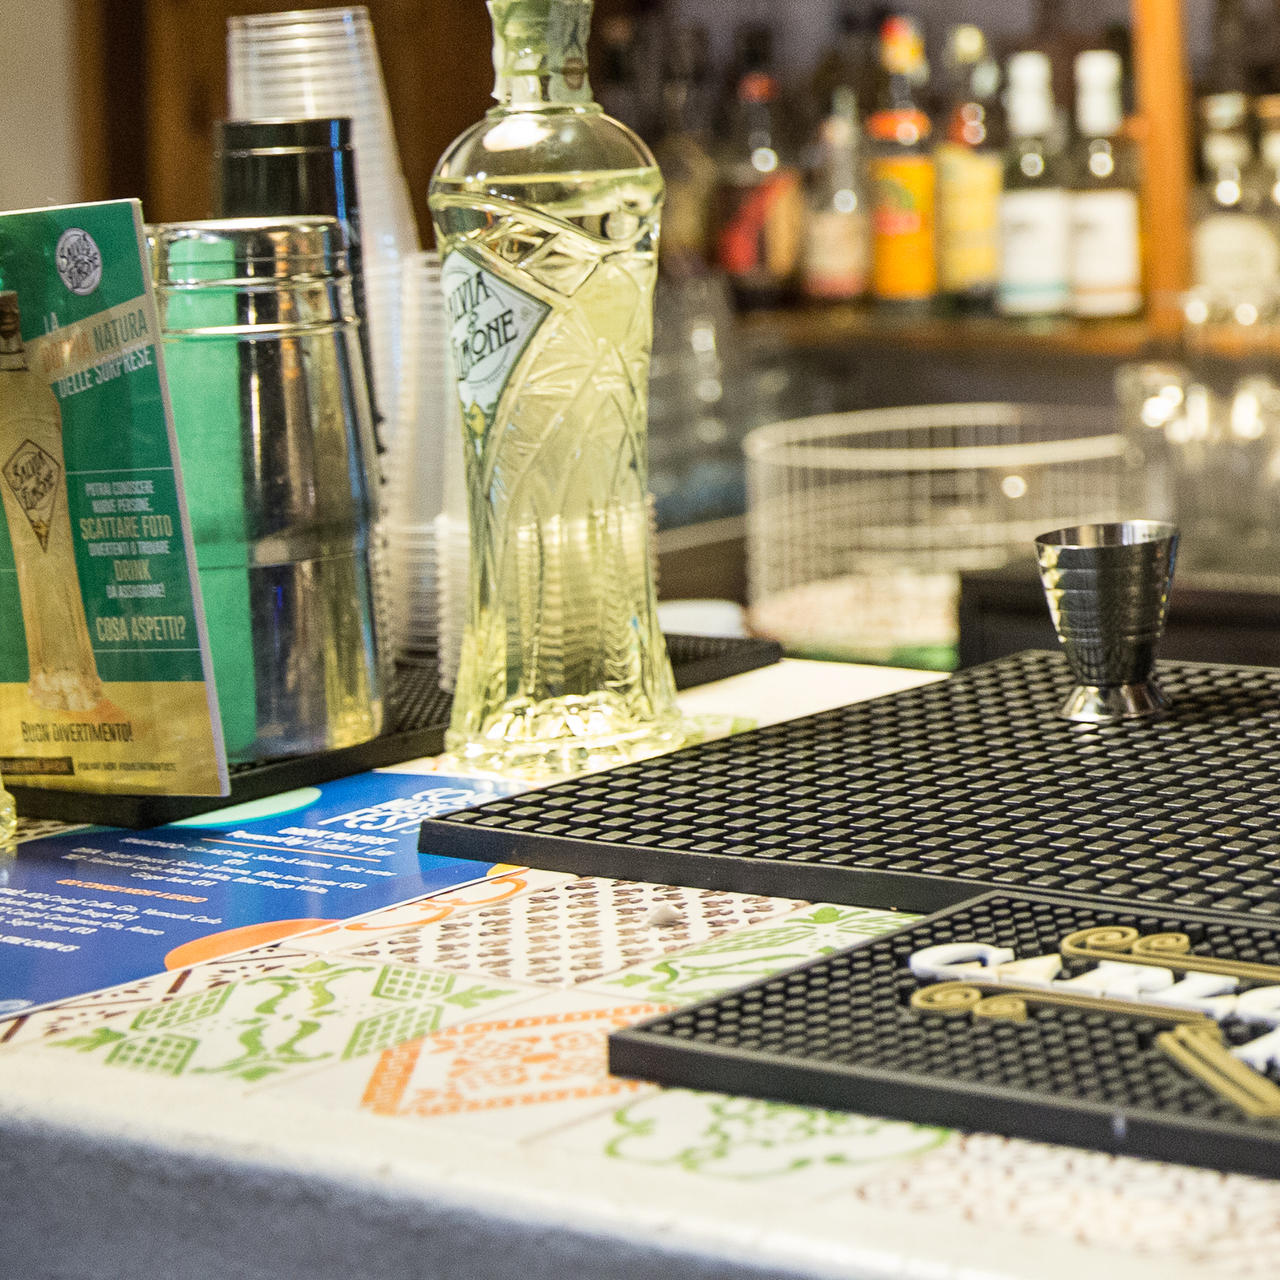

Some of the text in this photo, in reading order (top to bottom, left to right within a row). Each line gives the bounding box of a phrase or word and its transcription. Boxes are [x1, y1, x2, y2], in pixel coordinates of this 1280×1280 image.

[93, 308, 148, 352] NATURA
[79, 515, 173, 540] SCATTARE FOTO
[113, 559, 151, 582] DRINK
[95, 616, 187, 641] COSA ASPETTI?
[52, 721, 134, 742] DIVERTIMENTO!
